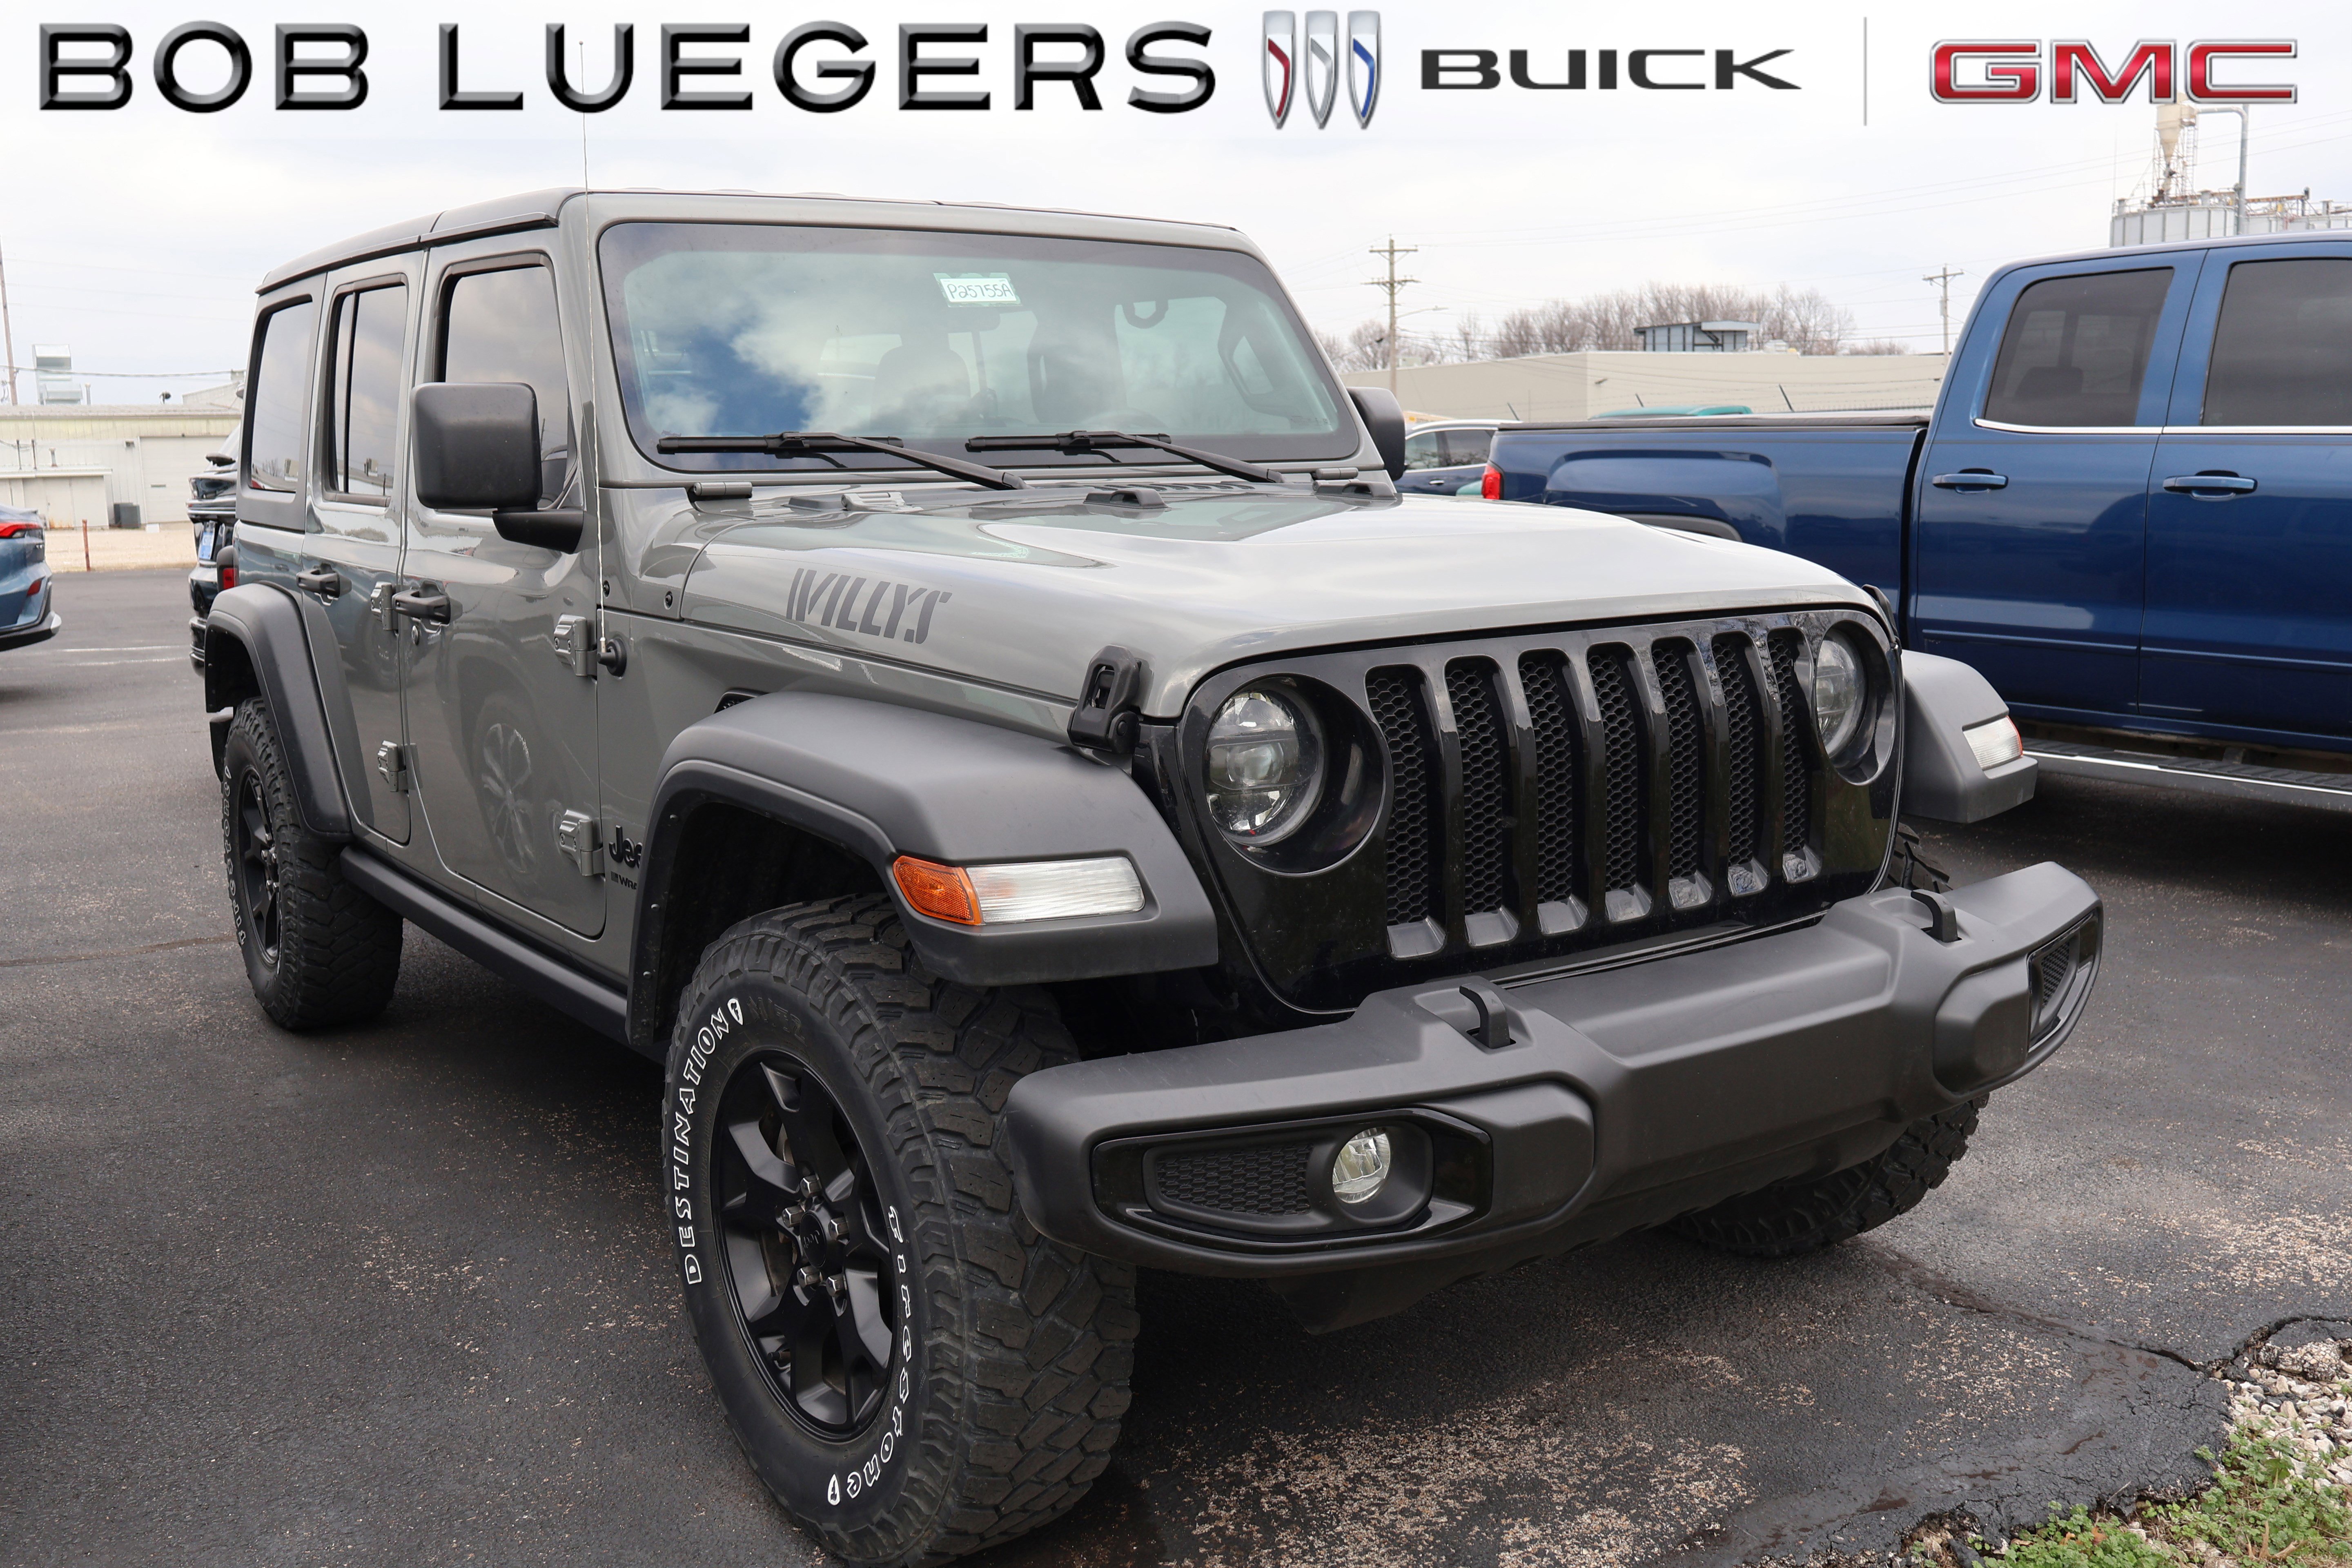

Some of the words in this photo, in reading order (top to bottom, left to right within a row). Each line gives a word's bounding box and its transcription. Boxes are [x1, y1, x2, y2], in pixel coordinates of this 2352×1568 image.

[947, 283, 1013, 299] P25755A
[786, 568, 953, 644] WILLYS
[674, 1010, 730, 1285] DESTINATION
